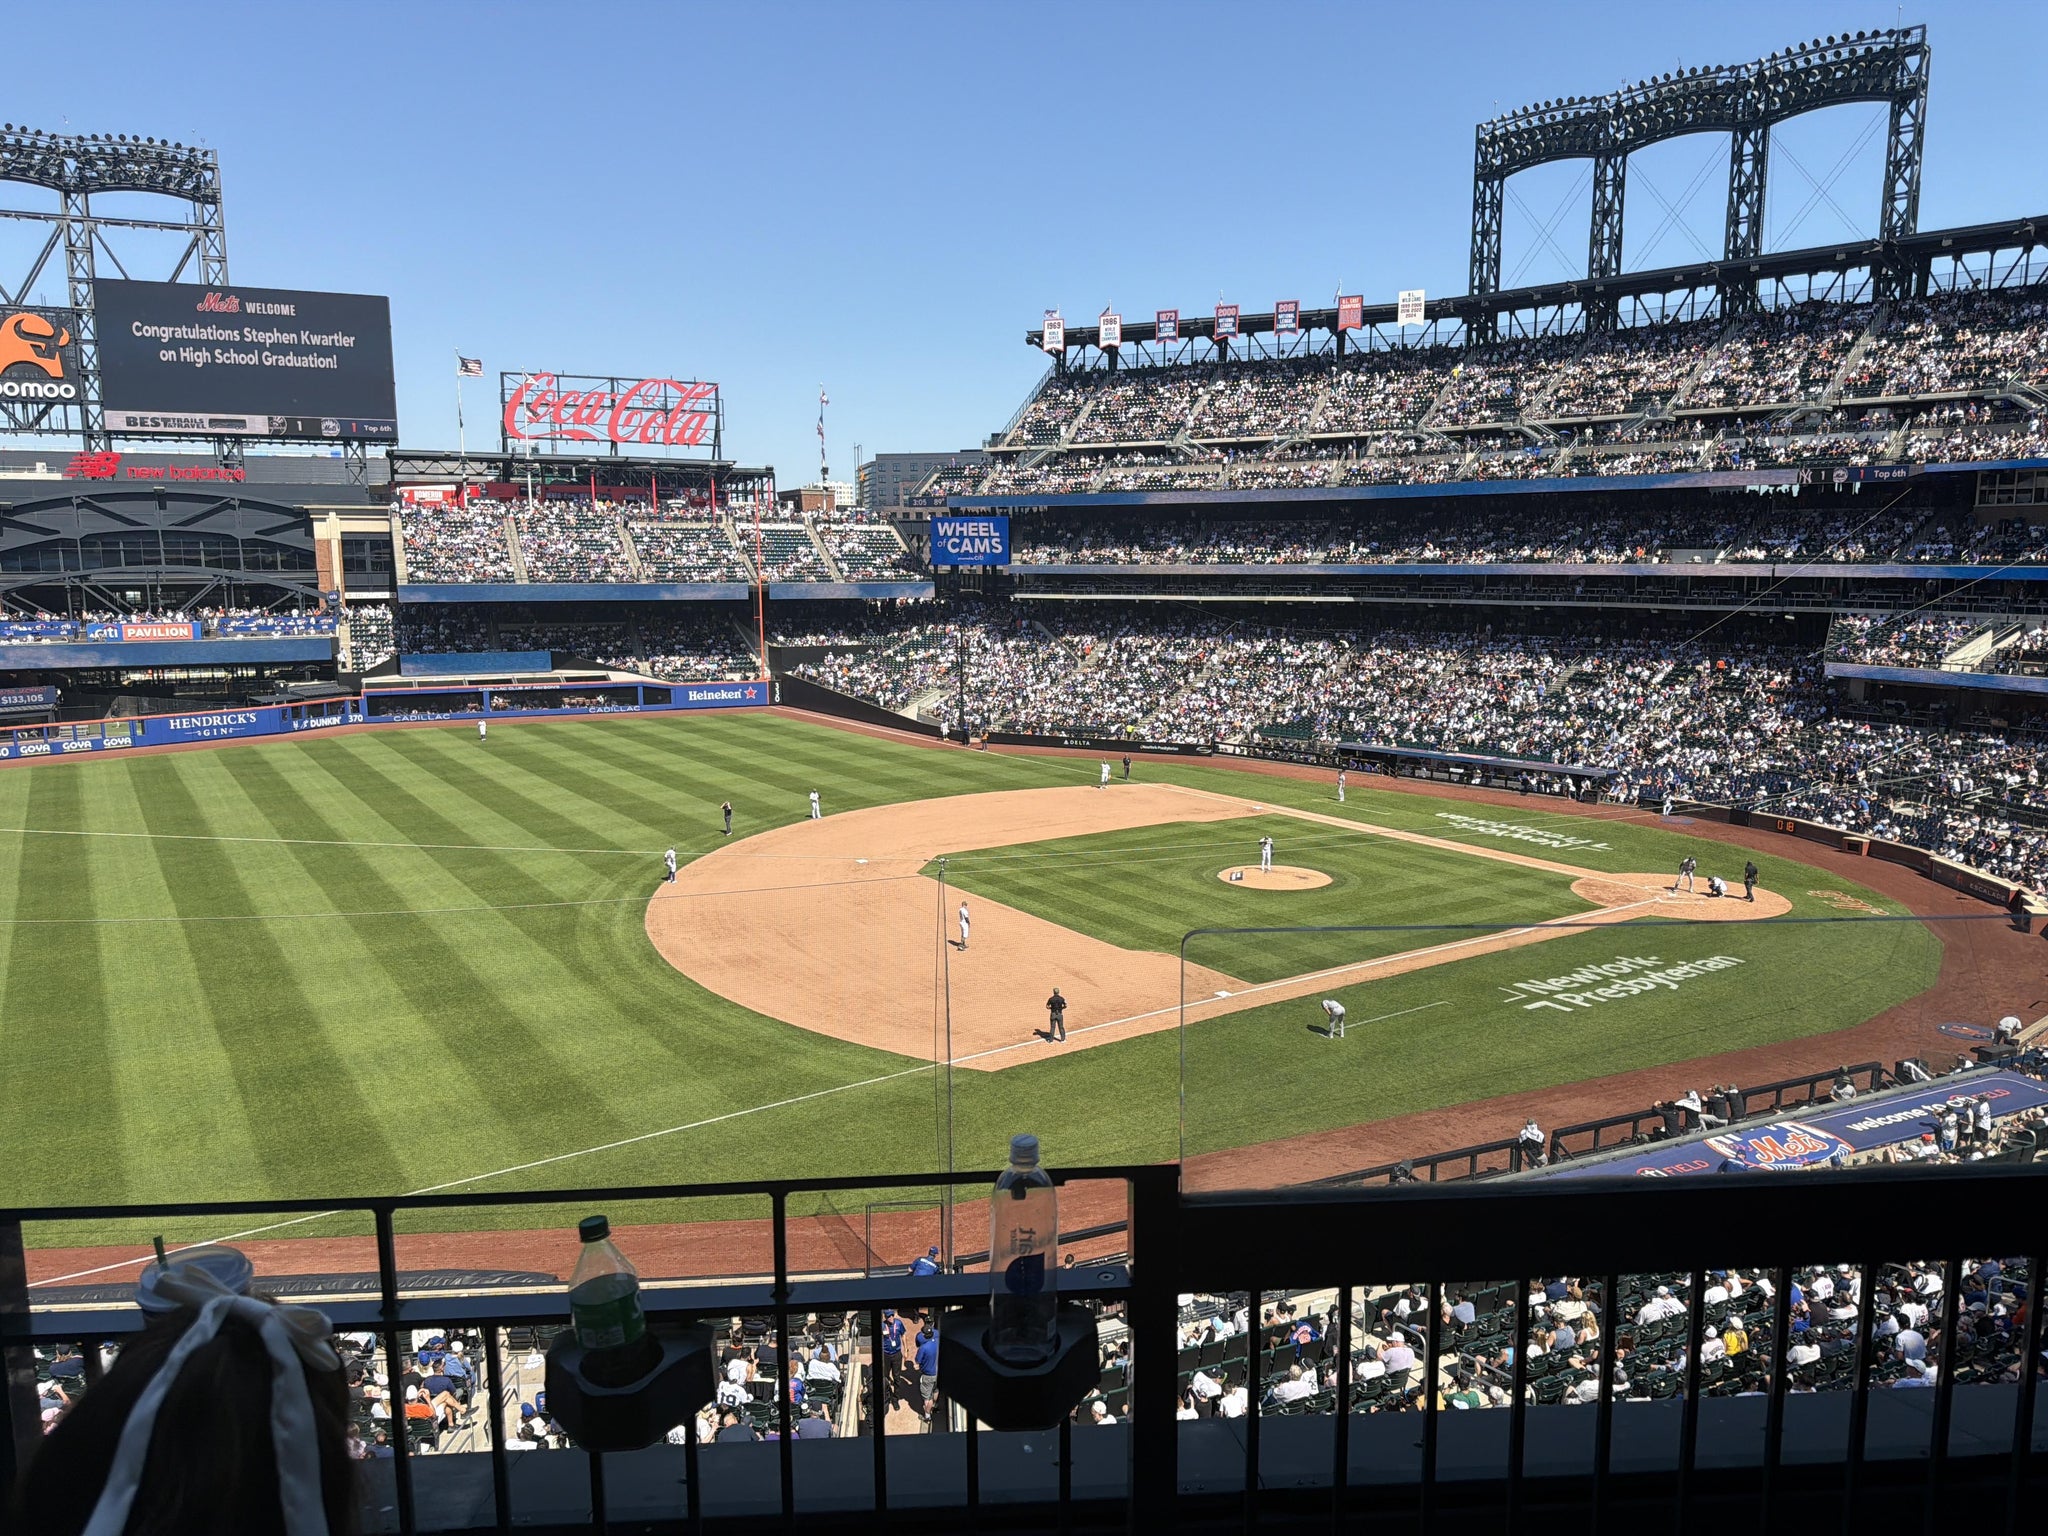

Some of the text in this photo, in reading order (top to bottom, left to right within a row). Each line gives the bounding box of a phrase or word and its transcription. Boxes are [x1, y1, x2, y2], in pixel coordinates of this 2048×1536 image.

[196, 292, 296, 316] Mets WELCOME
[1160, 312, 1175, 321] 1973
[1217, 307, 1236, 316] 2000
[132, 321, 355, 347] Congratulations Stephen Kwartler
[159, 347, 338, 369] on High School Graduation!
[0, 382, 76, 399] omoo
[504, 372, 719, 445] Coca-Cola
[125, 416, 171, 428] BEST
[297, 420, 302, 432] 1
[351, 422, 357, 432] 1
[364, 424, 392, 434] Top 6th
[126, 465, 246, 480] new balance
[1820, 470, 1825, 480] 1
[1859, 469, 1865, 480] 1
[1873, 469, 1907, 480] Top 6th
[937, 522, 1000, 537] WHEEL
[937, 537, 1003, 554] of CAMS
[127, 626, 189, 638] PAVILION
[1, 694, 44, 705] $133,105
[688, 689, 741, 701] Heineken
[589, 705, 641, 713] CADILLAC
[169, 712, 257, 730] HENDRICK'S
[310, 715, 342, 728] DUNKIN'
[348, 714, 364, 723] 370
[393, 712, 451, 722] CADILLAC
[203, 728, 228, 737] GIN
[62, 740, 92, 751] GOYA
[103, 737, 132, 747] GOYA
[20, 744, 51, 754] GOYA
[1969, 883, 2006, 902] ESCALADE
[1552, 956, 1746, 1008] Presbyterian
[1846, 1107, 1929, 1132] welcome
[1750, 1133, 1828, 1164] Mets
[1662, 1160, 1709, 1176] FIELD
